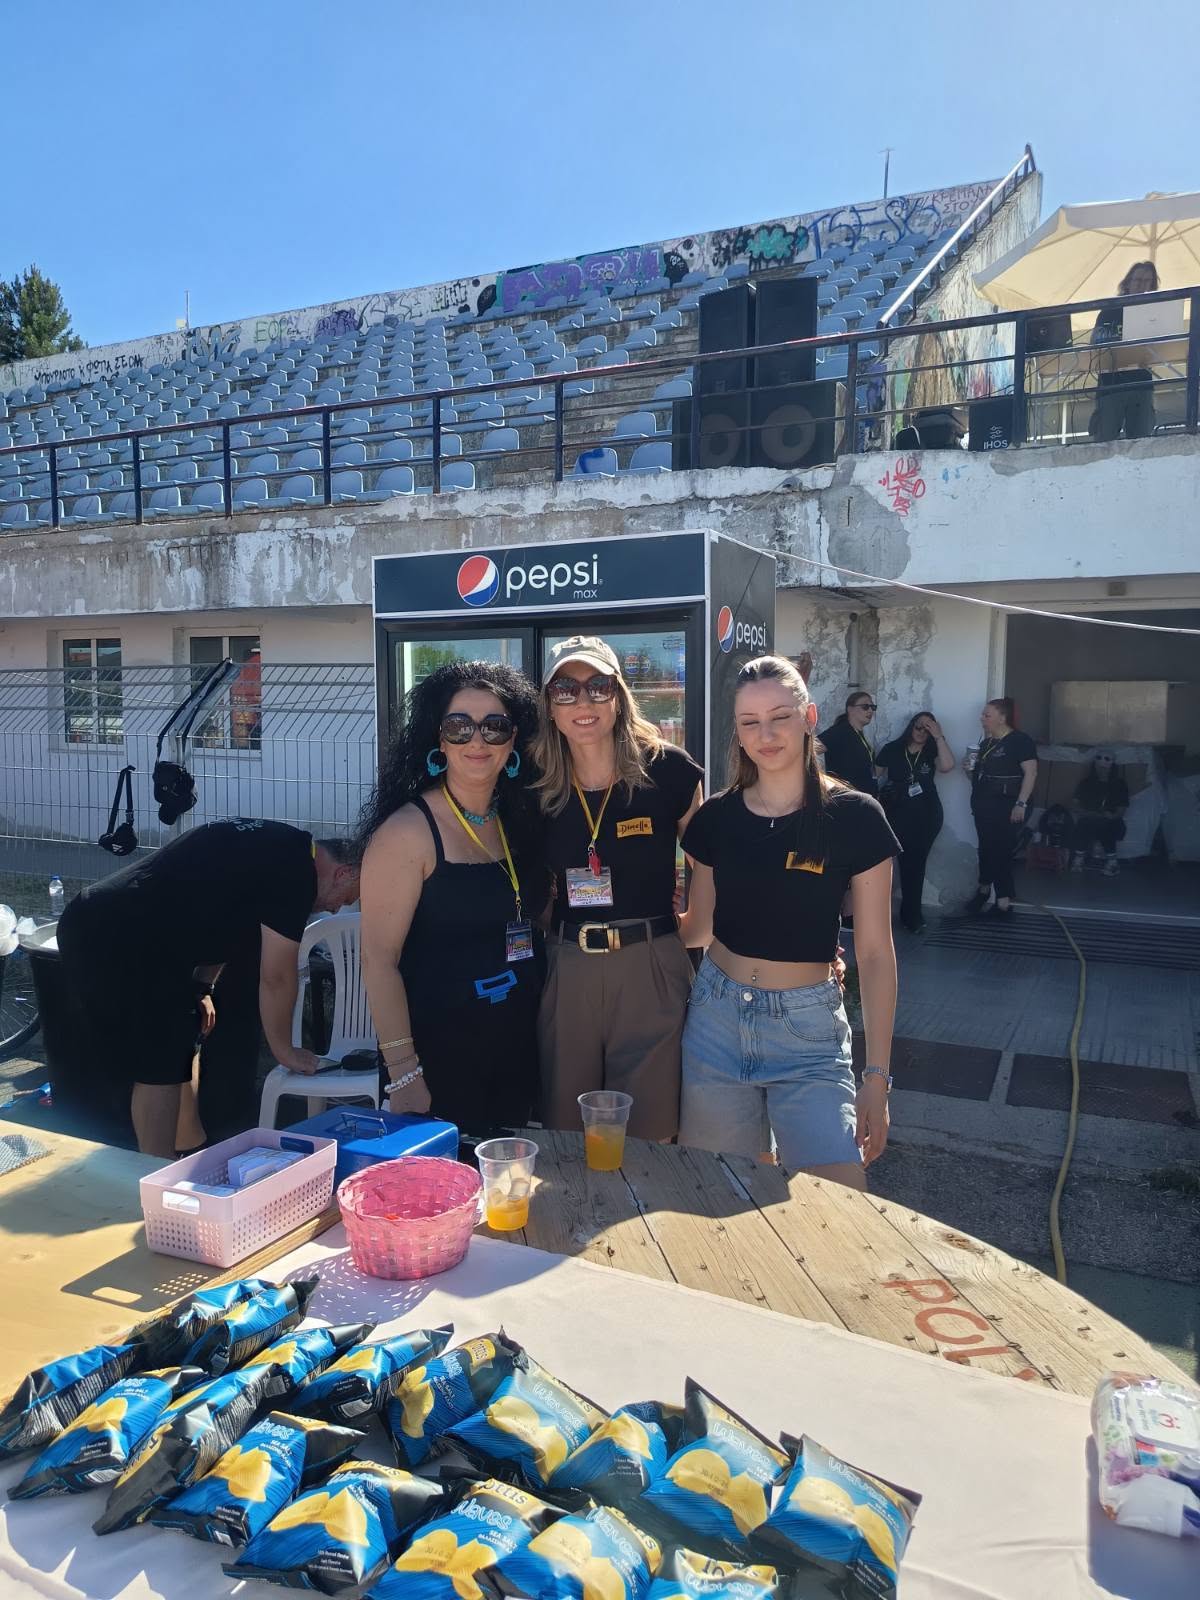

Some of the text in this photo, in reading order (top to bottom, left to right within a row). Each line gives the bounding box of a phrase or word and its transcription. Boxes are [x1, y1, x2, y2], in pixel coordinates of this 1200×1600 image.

[983, 440, 1009, 450] IHOS
[506, 553, 599, 599] pepsi
[573, 588, 599, 600] max
[735, 621, 767, 651] pepsi
